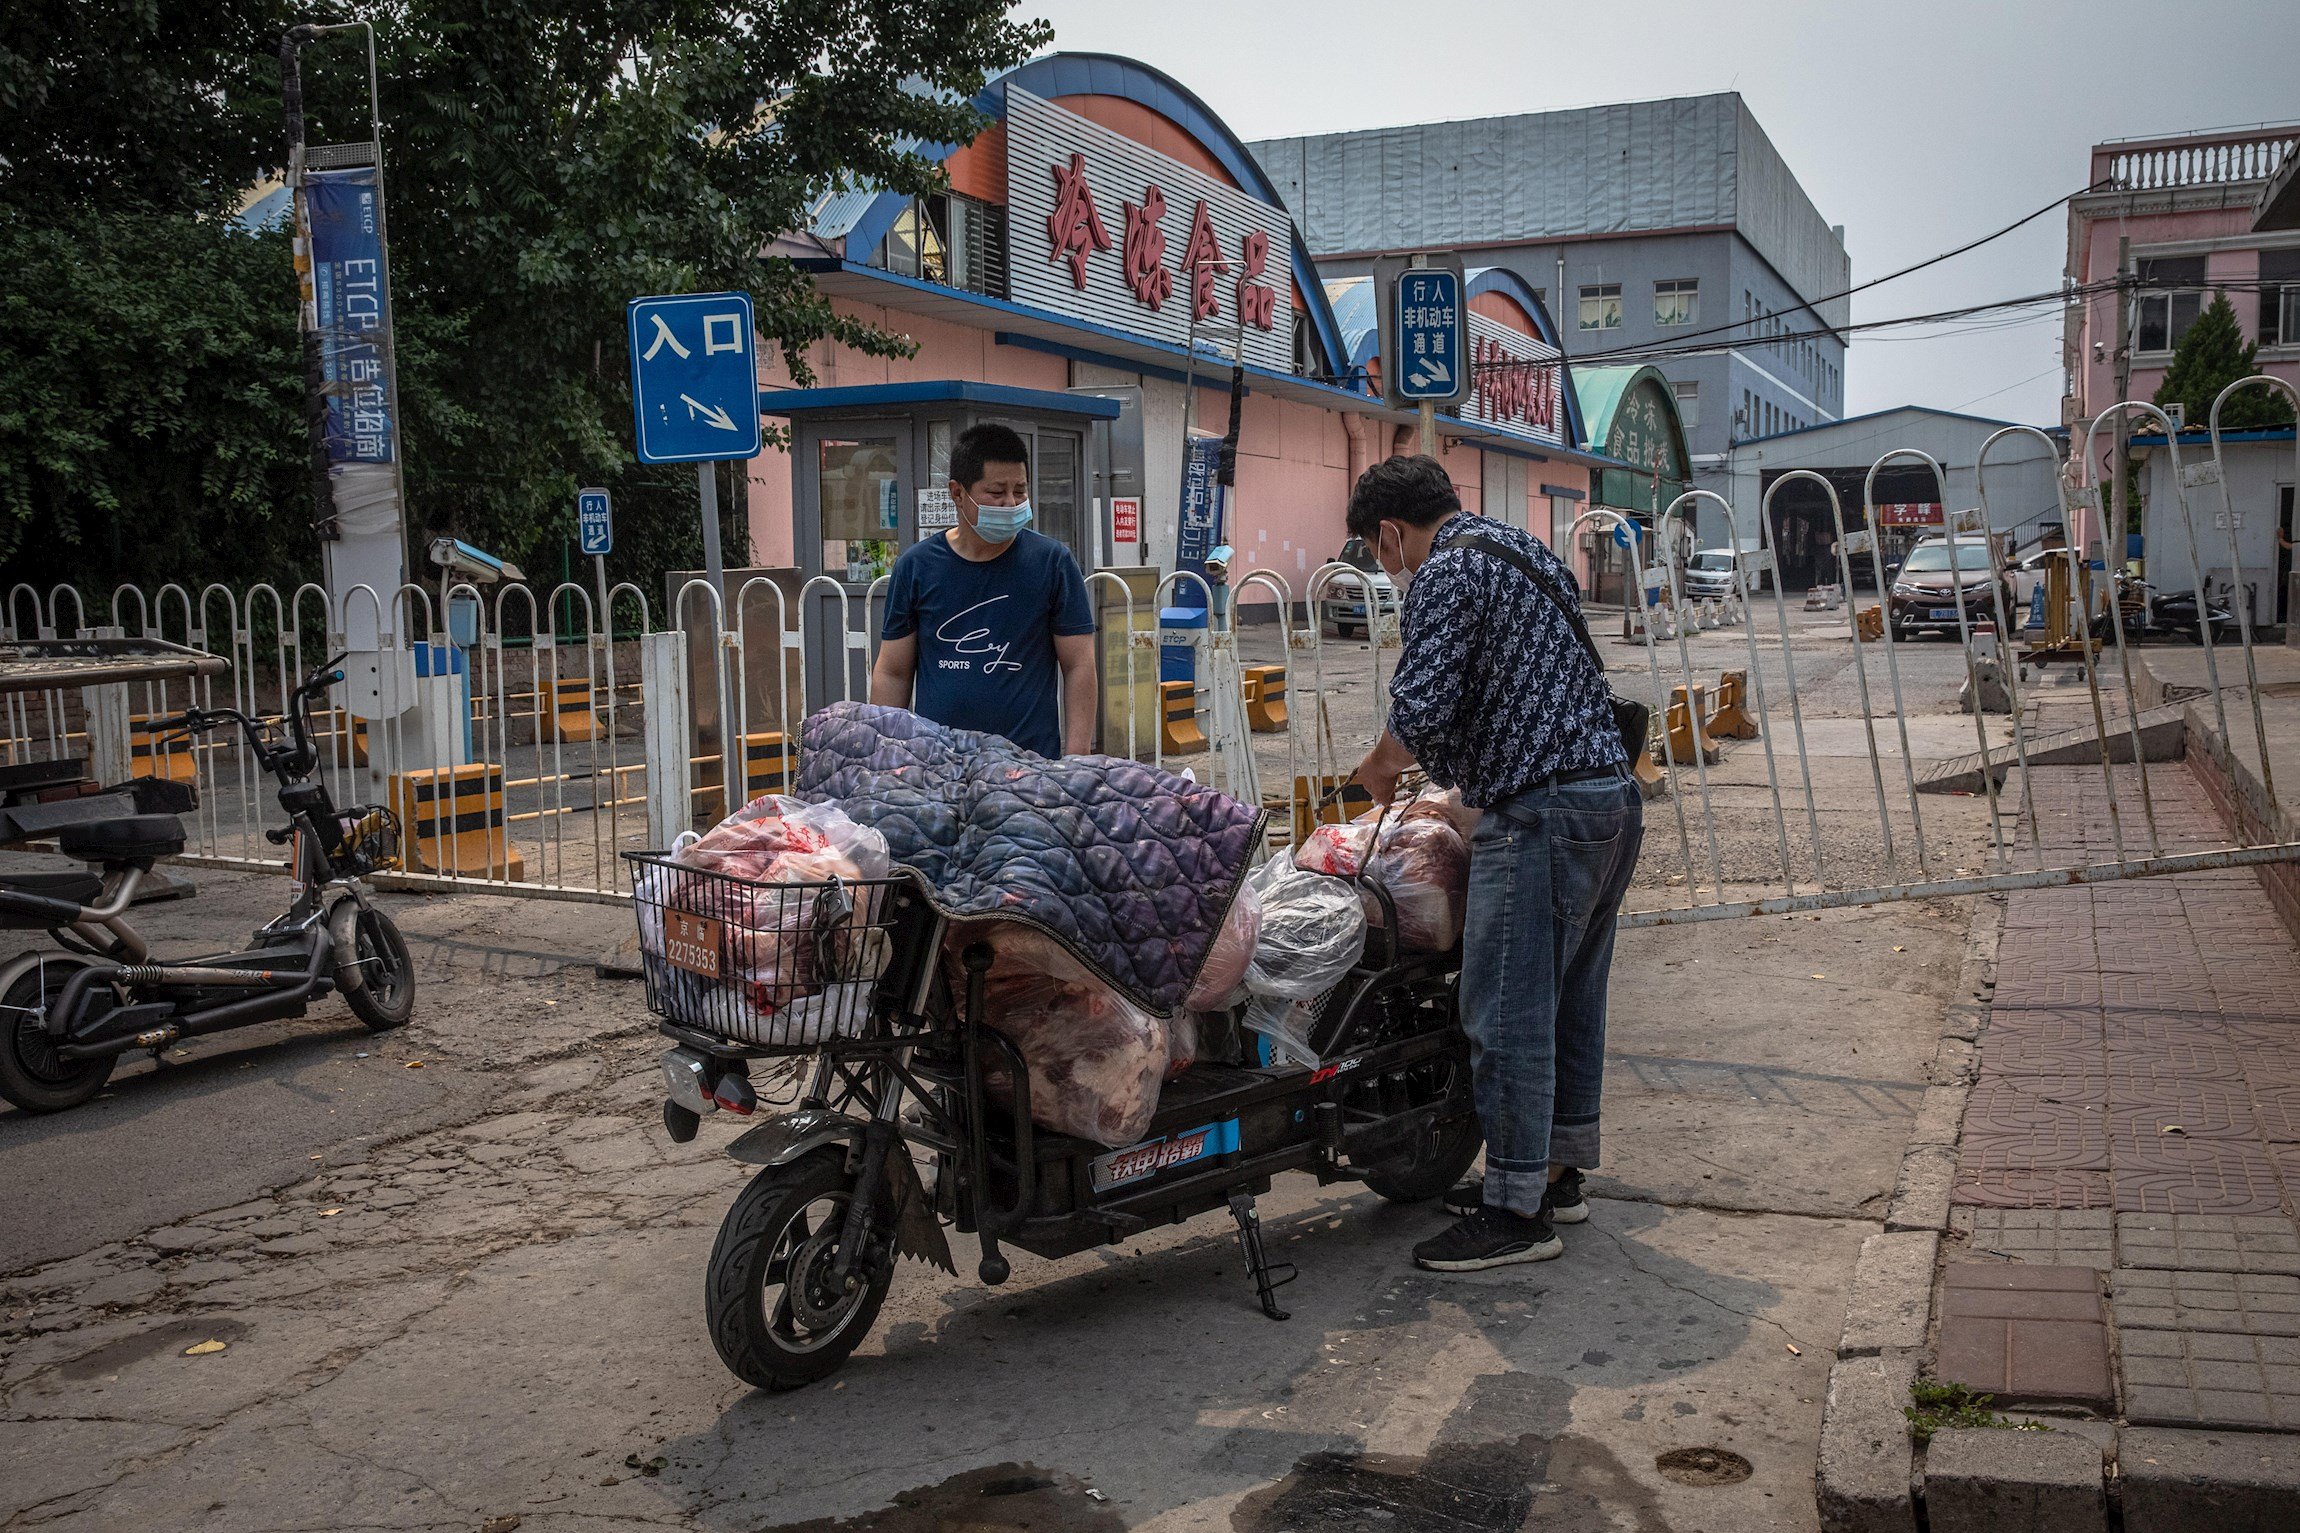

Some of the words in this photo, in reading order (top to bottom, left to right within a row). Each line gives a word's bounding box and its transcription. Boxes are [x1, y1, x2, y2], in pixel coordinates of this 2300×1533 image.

[363, 206, 373, 234] ETCP
[1047, 153, 1276, 331] 冷冻食品
[1413, 279, 1444, 302] 行人
[1404, 305, 1454, 329] 非机动车
[642, 313, 744, 362] 入口
[1413, 331, 1445, 354] 通道
[1626, 390, 1657, 431] 冷冻
[586, 500, 603, 511] 行人
[583, 512, 608, 523] 非机动车
[921, 513, 959, 524] 登记身份信
[1163, 635, 1187, 645] ETCP
[938, 659, 971, 670] SPORTS
[669, 938, 716, 971] 2275353
